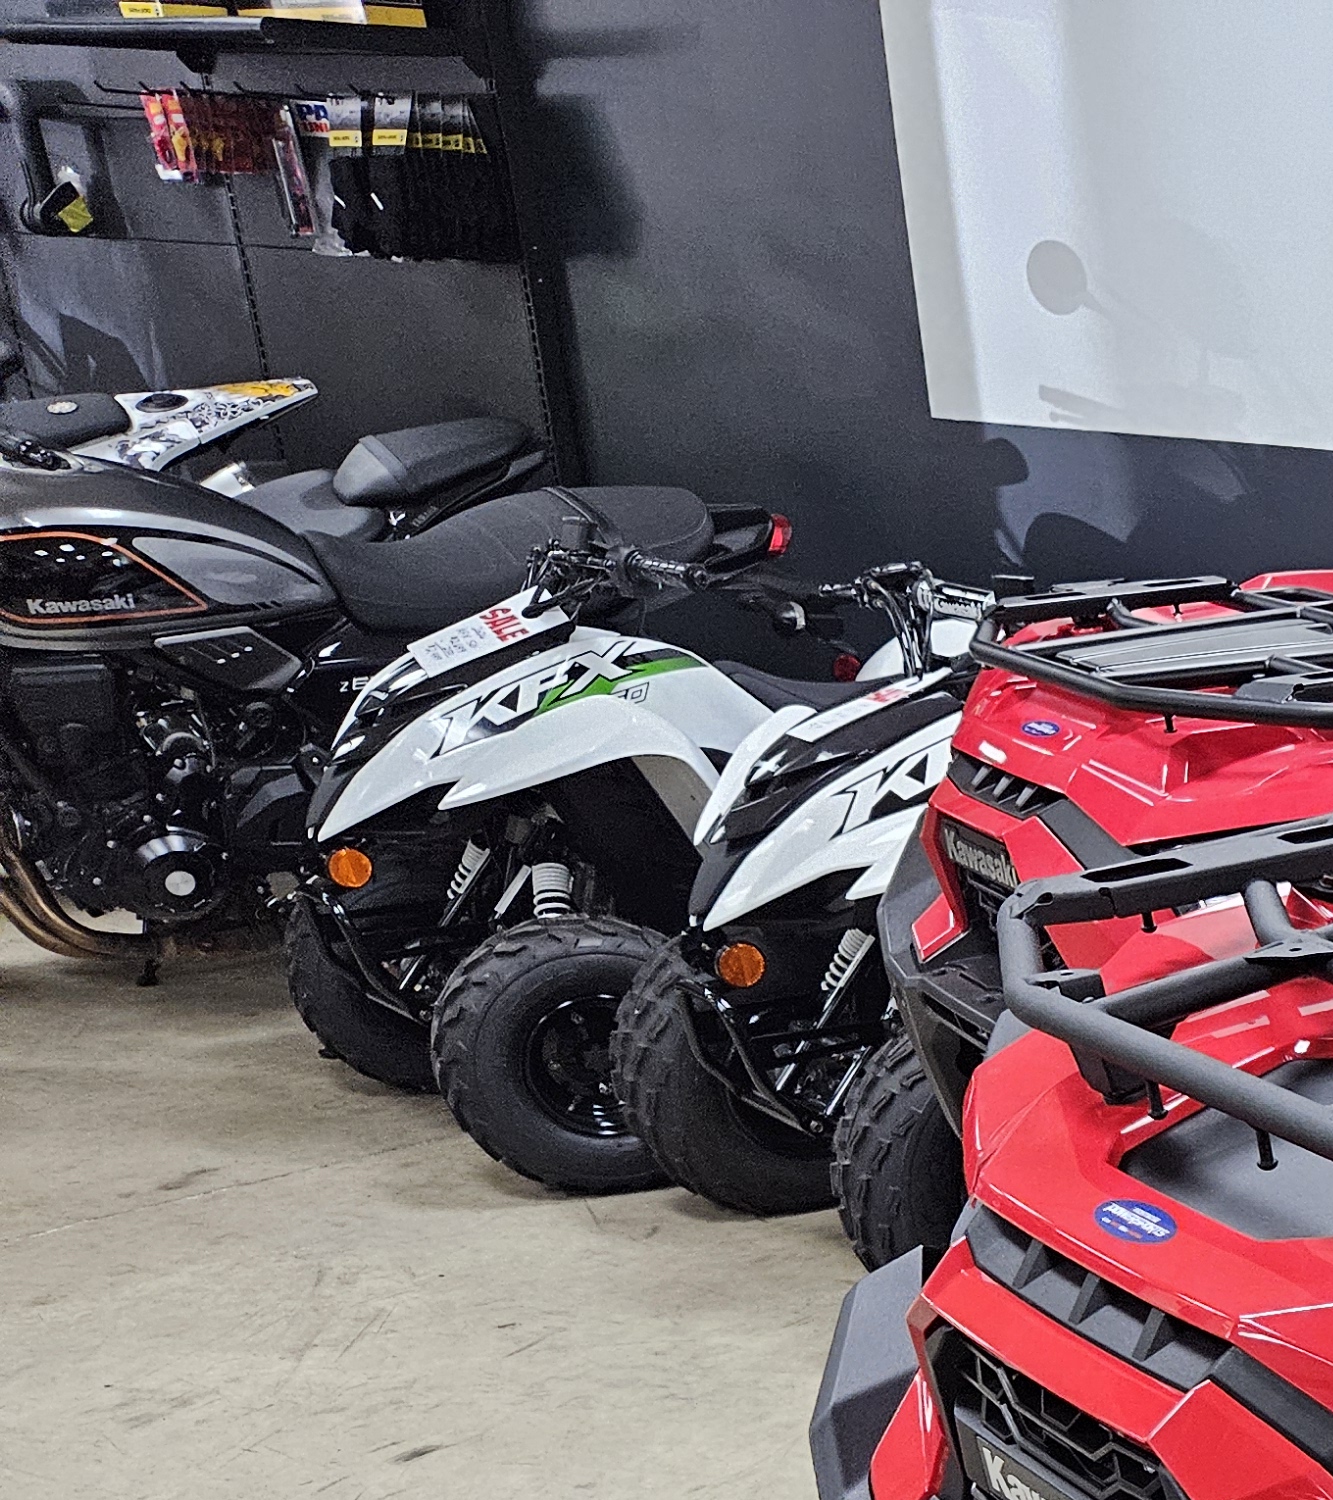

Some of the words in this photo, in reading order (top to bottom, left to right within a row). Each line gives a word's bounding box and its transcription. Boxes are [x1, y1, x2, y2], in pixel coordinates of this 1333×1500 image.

[26, 593, 136, 615] Kawasaki
[480, 607, 530, 643] SALE
[430, 641, 643, 759] KFX
[944, 828, 1019, 889] Kawasaki
